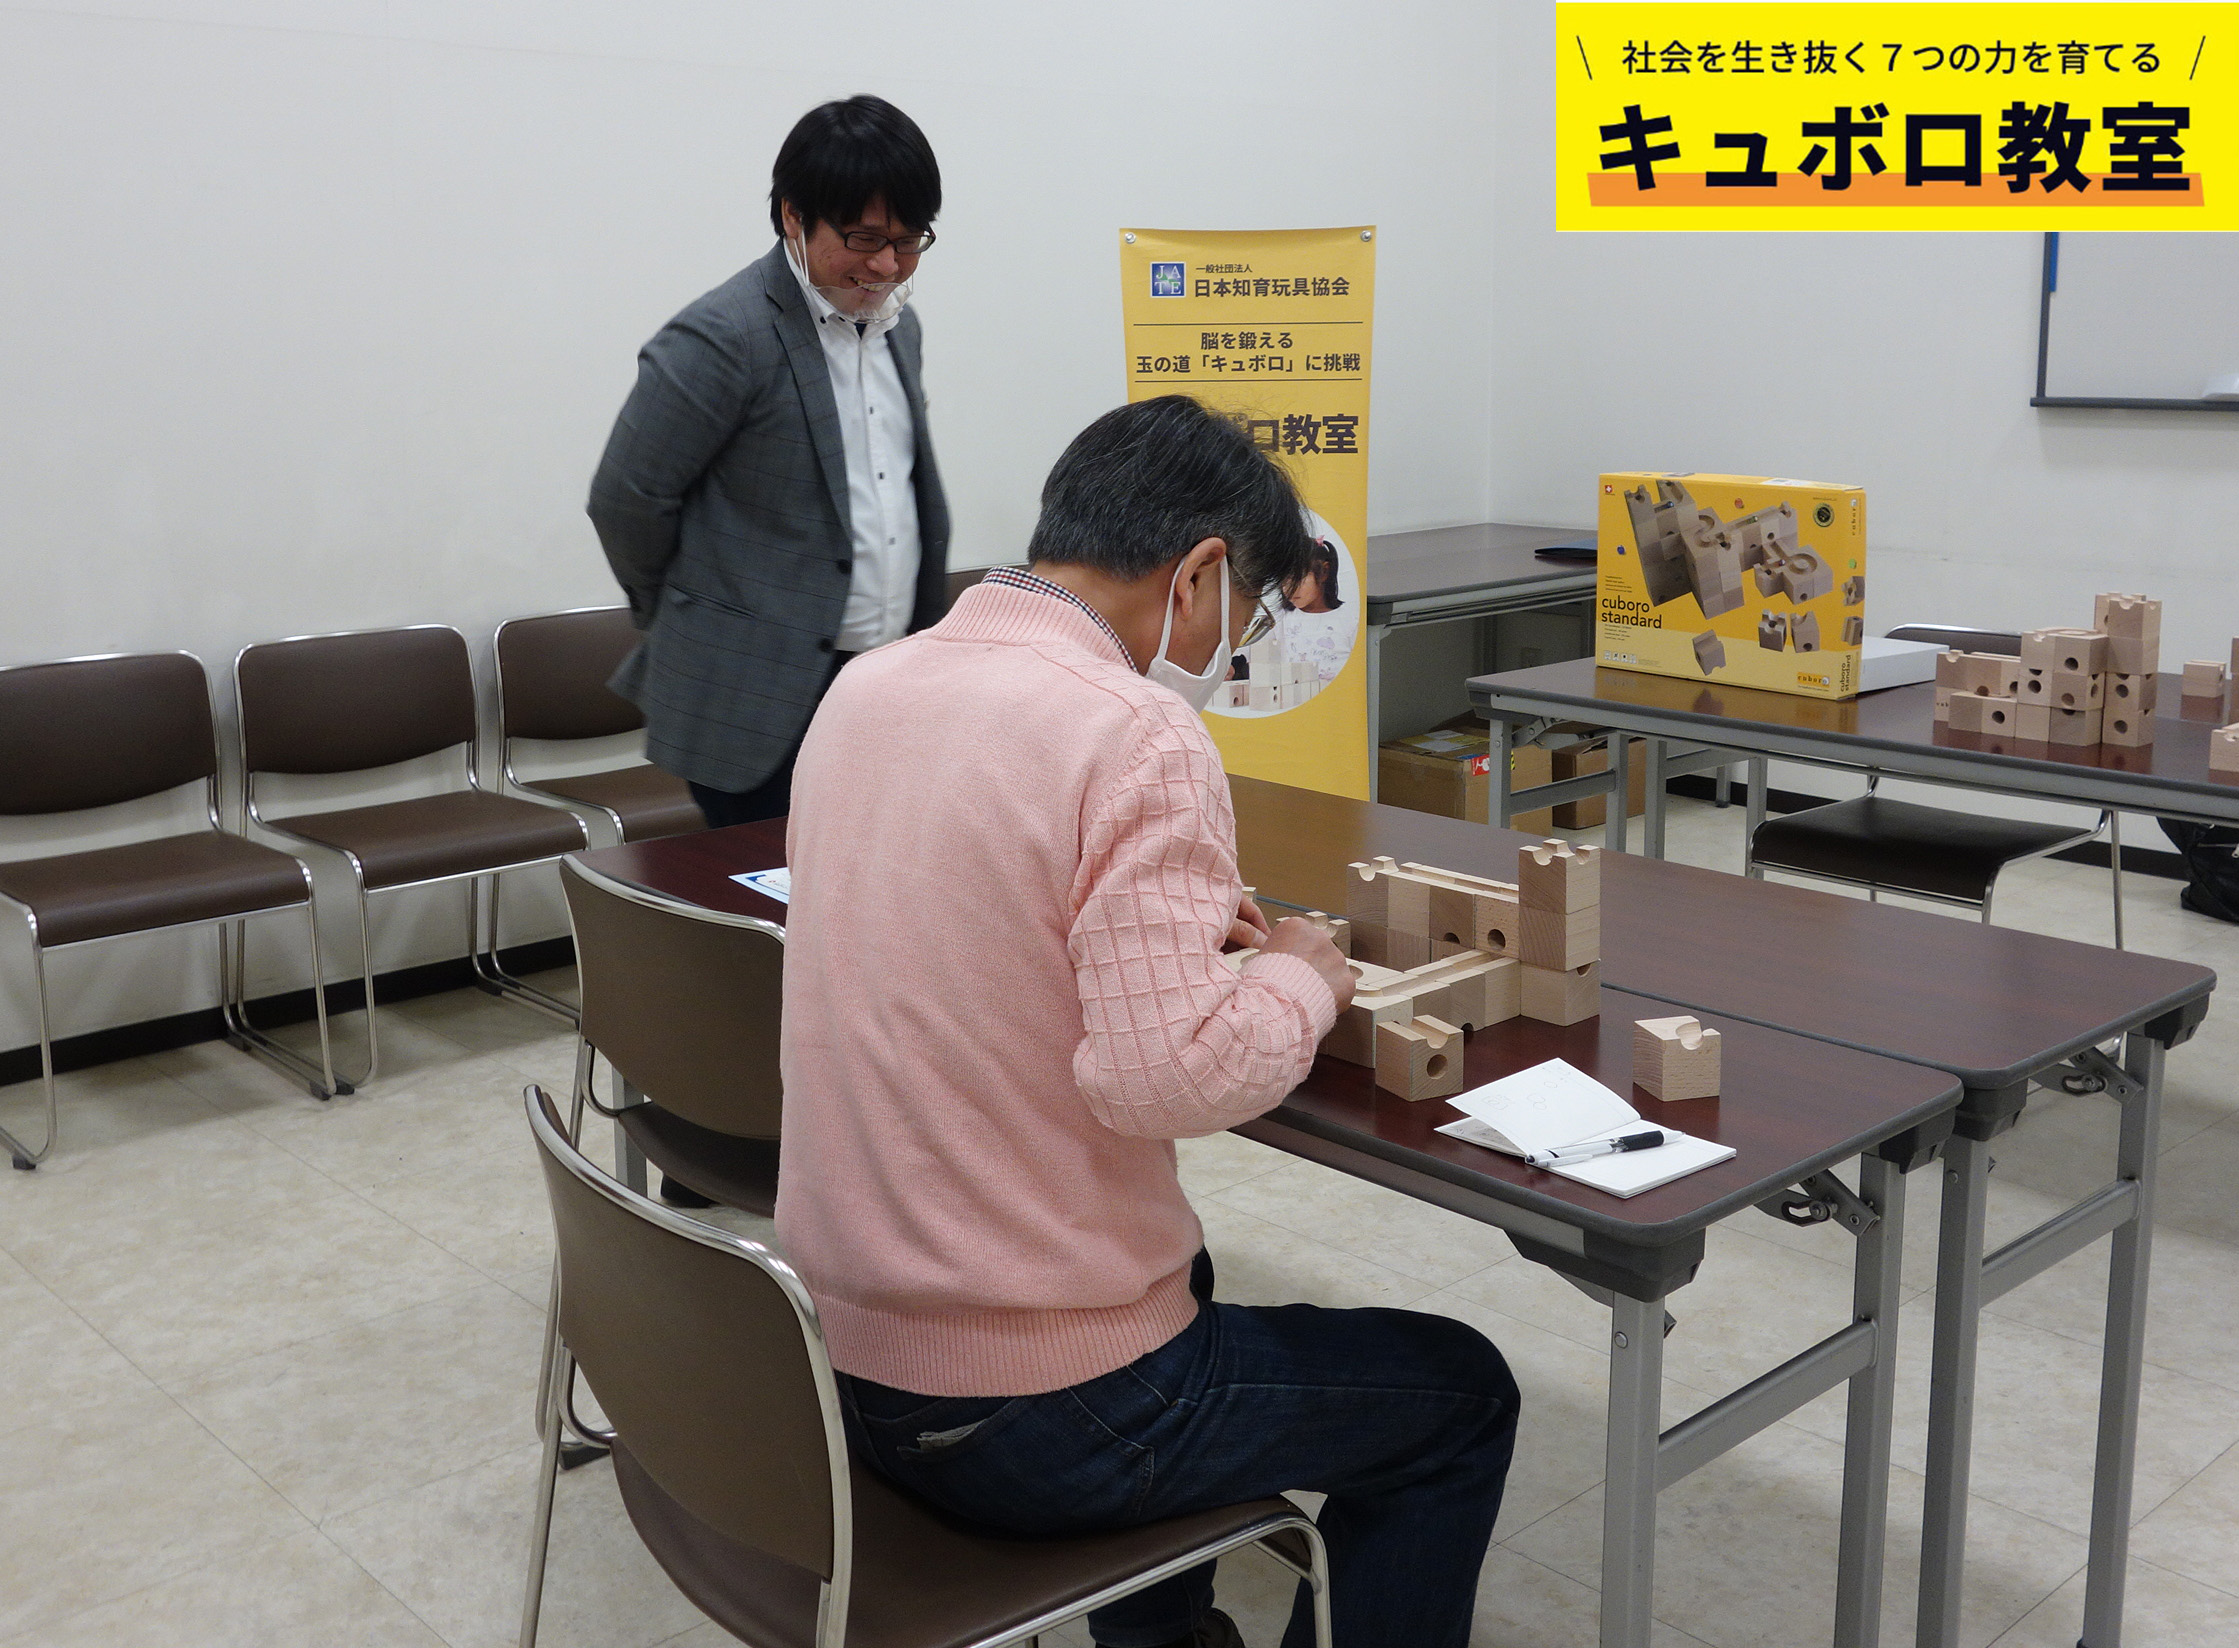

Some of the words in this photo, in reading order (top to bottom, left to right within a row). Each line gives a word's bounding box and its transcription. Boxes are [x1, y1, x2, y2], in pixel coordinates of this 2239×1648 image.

[1195, 263, 1253, 274] 一般社団法人
[1194, 276, 1350, 298] 日本知育玩具協会
[1200, 331, 1294, 351] 脳を鍛える
[1136, 353, 1361, 374] 玉の道「キュボロ」に挑戦
[1601, 595, 1650, 613] cuboro
[1601, 611, 1662, 629] standard
